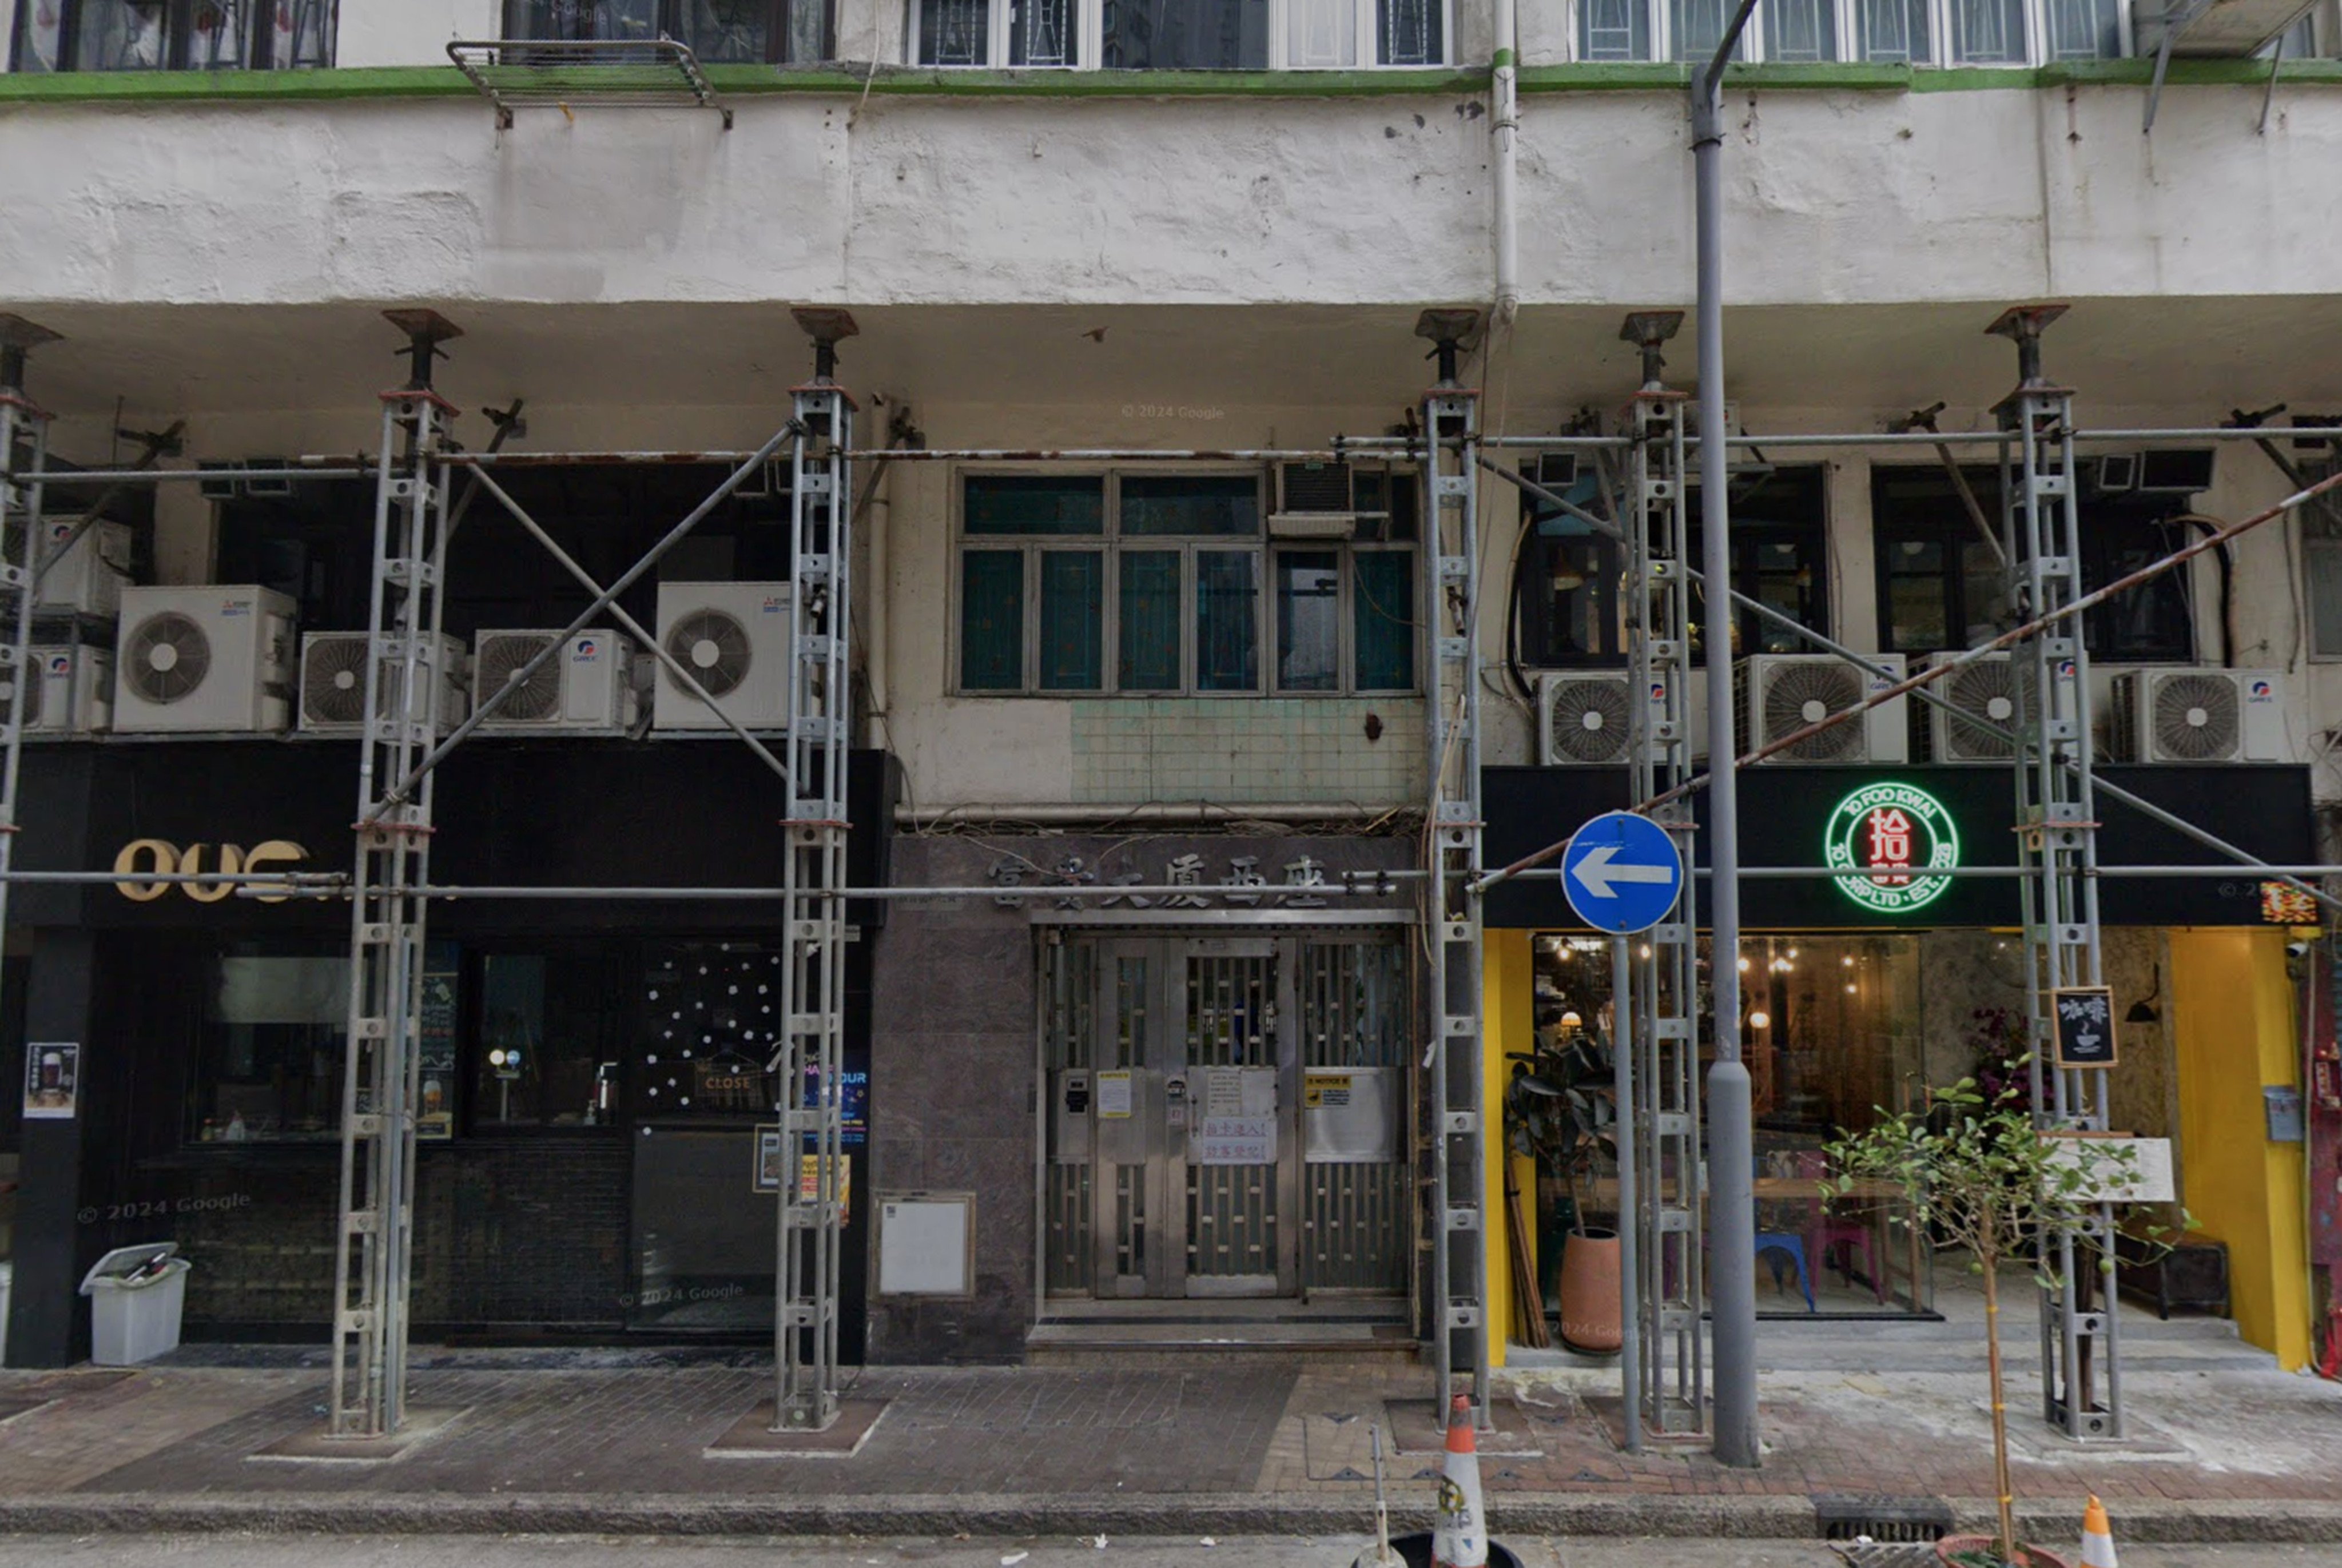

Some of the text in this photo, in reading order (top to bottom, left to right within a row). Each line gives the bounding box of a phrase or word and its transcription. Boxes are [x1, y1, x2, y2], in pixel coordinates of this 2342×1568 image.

[1843, 789, 1938, 819] 10 FOO KWAI
[1868, 808, 1911, 861] 拾
[1870, 890, 1901, 907] LTD
[705, 1077, 750, 1089] CLOSE
